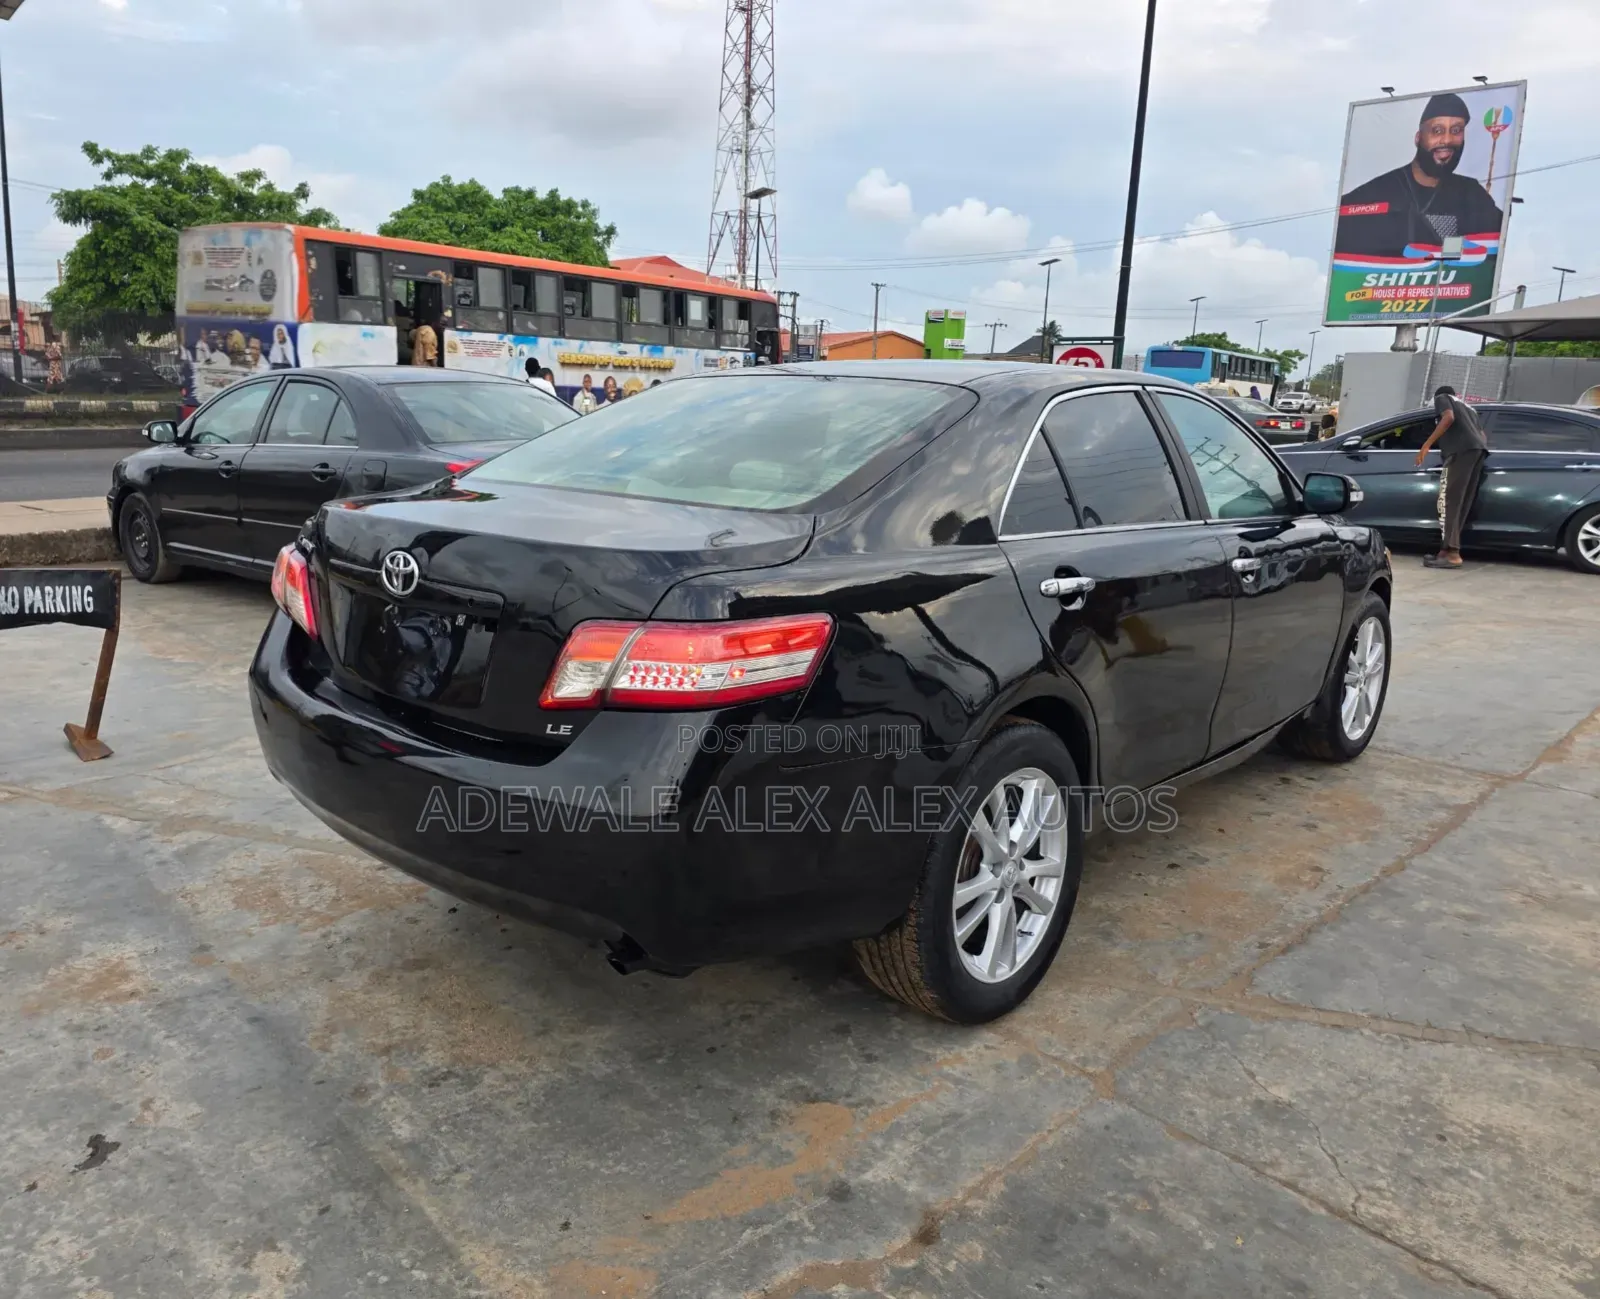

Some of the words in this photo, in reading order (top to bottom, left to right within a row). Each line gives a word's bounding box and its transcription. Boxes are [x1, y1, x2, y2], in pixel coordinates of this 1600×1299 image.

[1348, 204, 1380, 214] SUPPORT
[1362, 269, 1457, 287] SHITTU
[1350, 291, 1367, 300] FOR
[1373, 288, 1396, 299] HOUSE
[1397, 288, 1406, 298] OF
[1380, 299, 1430, 313] 2027
[558, 353, 598, 367] SEASON
[598, 355, 612, 367] OF
[23, 585, 94, 614] PARKING
[546, 723, 574, 735] LE
